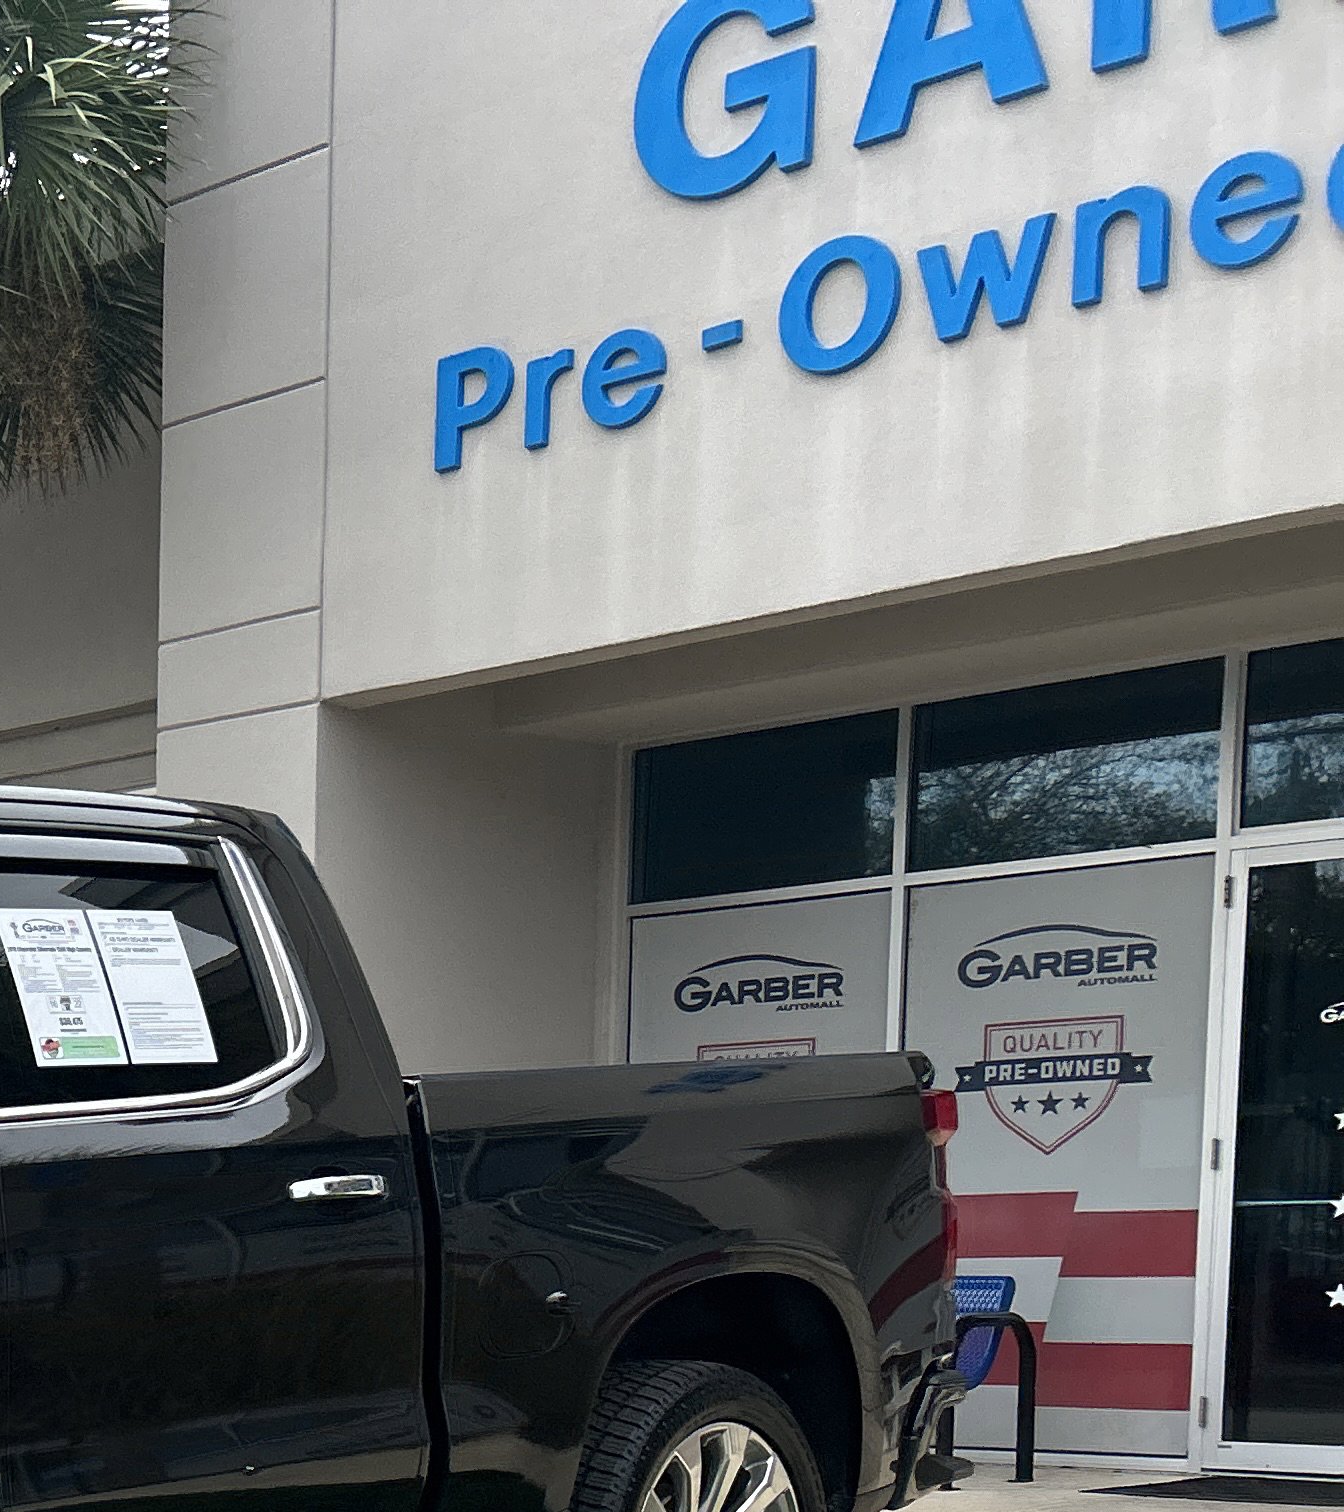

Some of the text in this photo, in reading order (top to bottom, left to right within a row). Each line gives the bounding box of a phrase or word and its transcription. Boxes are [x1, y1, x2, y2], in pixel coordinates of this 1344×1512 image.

[433, 143, 1344, 472] Pre-Owne
[957, 942, 1158, 989] GARBER
[673, 972, 845, 1013] GARBER
[1077, 973, 1158, 987] AUTOMALL
[775, 1000, 845, 1012] AUTOMALL
[1002, 1029, 1104, 1055] QUALITY
[984, 1057, 1121, 1083] PRE-OWNED
